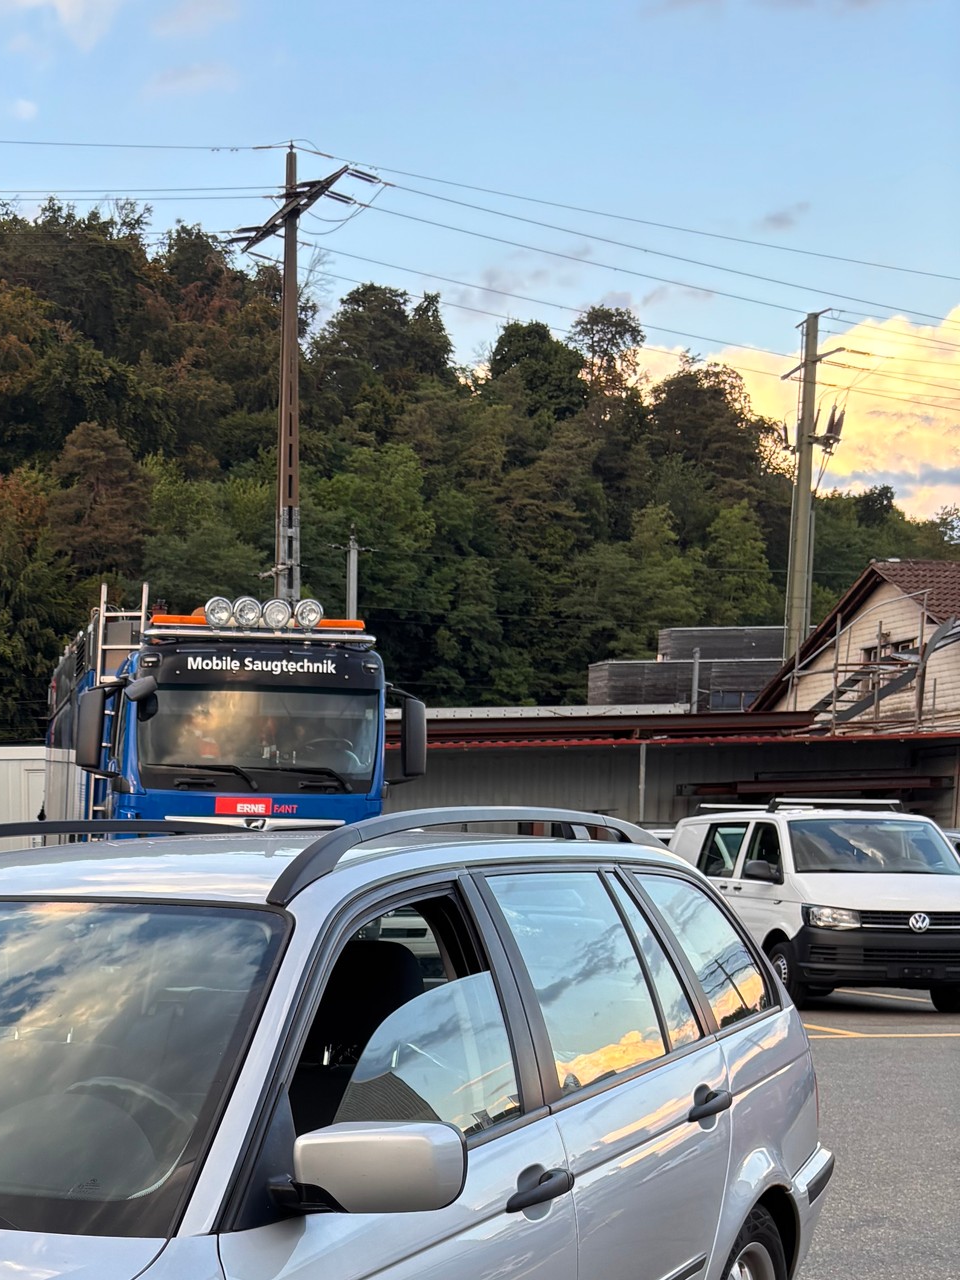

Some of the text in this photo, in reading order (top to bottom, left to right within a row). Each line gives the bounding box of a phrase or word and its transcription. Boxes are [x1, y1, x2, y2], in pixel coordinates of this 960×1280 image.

[187, 656, 337, 675] Mobile Saugtechnik
[236, 803, 298, 814] ERNE FANT
